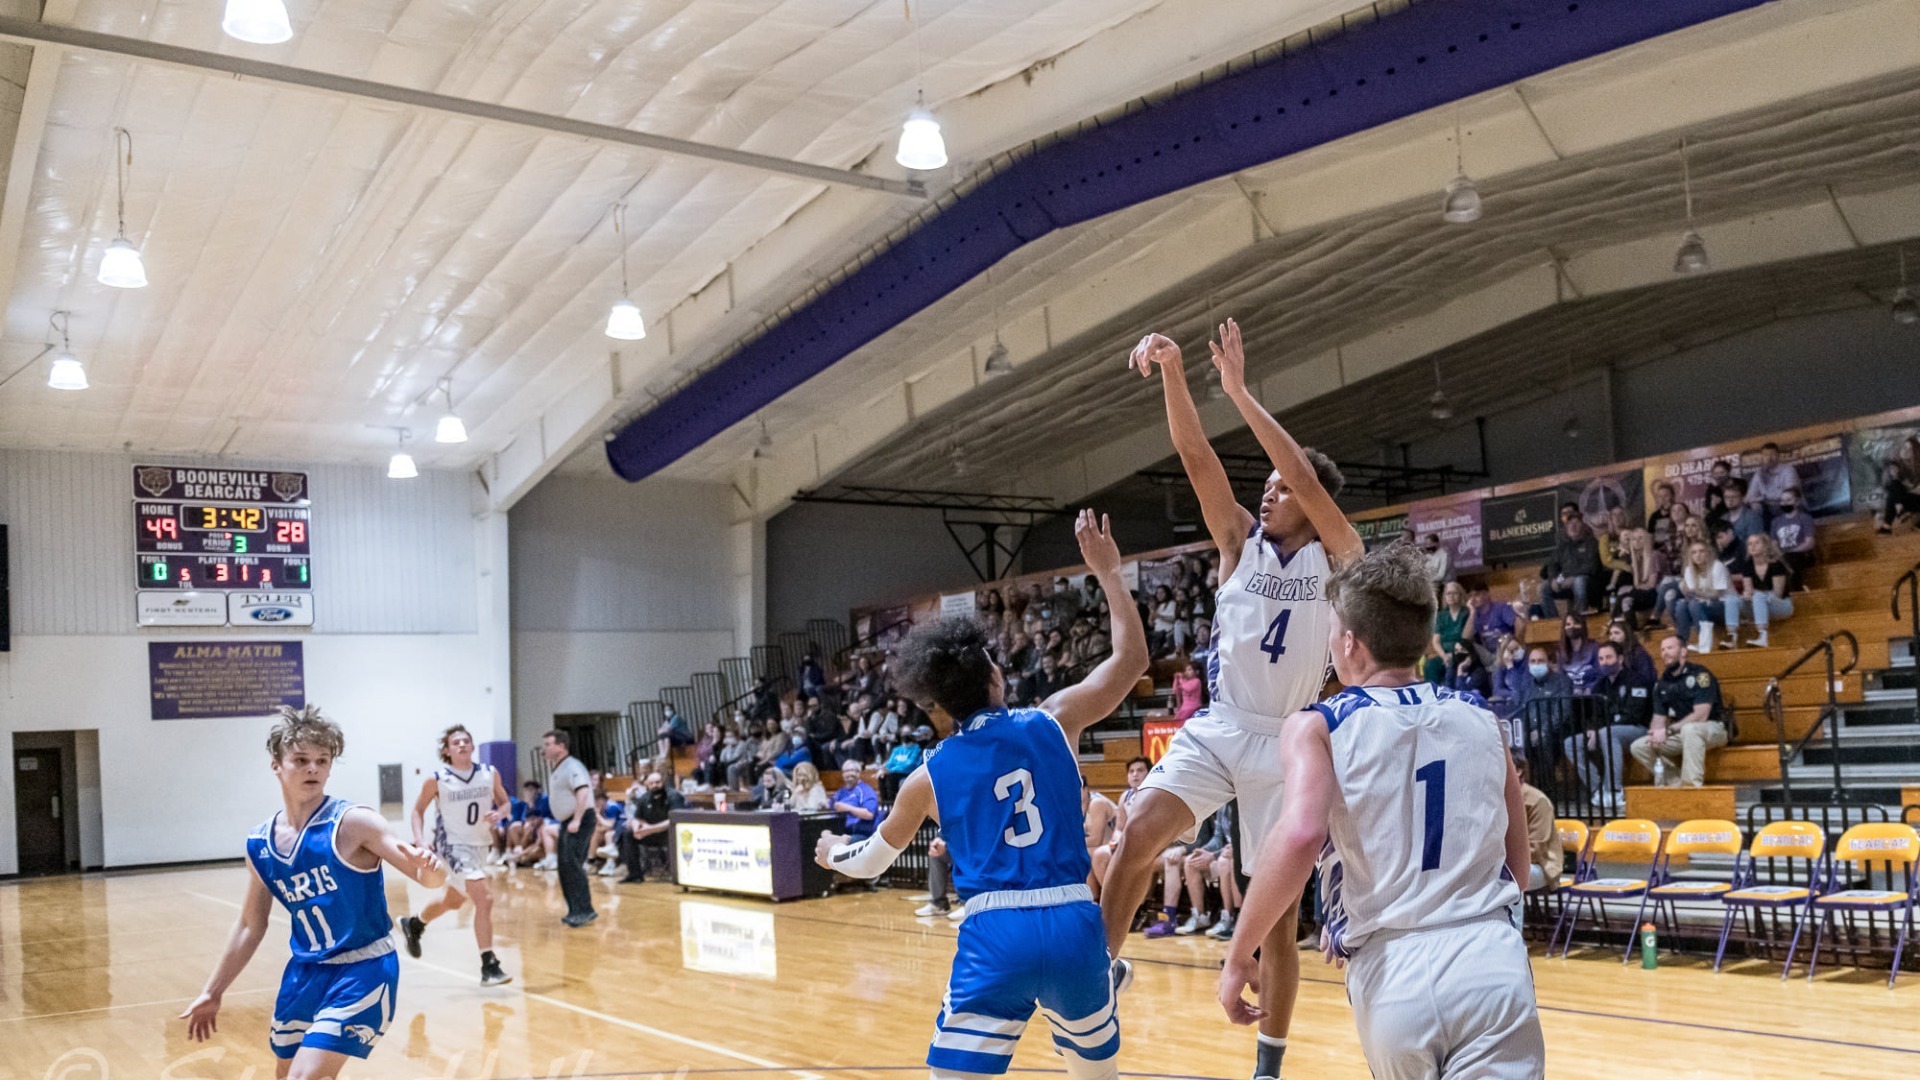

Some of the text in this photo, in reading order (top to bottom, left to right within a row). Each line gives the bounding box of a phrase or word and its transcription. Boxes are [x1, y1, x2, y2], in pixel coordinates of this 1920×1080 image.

[1681, 454, 1739, 475] BEARTS
[176, 470, 268, 487] BOONEVILLE
[184, 484, 262, 500] BEARCATS
[141, 505, 174, 515] HOME
[202, 507, 260, 530] 3:42
[268, 508, 308, 519] VISITOR
[146, 518, 177, 540] 49
[276, 521, 305, 543] 28
[1490, 520, 1554, 541] BLANKENSHIP
[157, 542, 183, 550] BONUS
[202, 538, 231, 547] PERIOD
[234, 535, 248, 553] 3
[266, 544, 291, 552] BONUS
[141, 556, 167, 564] FOULS
[198, 556, 259, 565] PLAYER FOULS
[283, 558, 307, 566] FOULS
[153, 563, 168, 581] 0
[240, 594, 302, 604] TYLER
[257, 609, 285, 622] Ford
[1260, 608, 1292, 664] 4
[174, 644, 283, 659] ALMA MATER
[467, 801, 479, 826] 0
[993, 768, 1044, 848] 3
[1415, 759, 1446, 872] 1
[274, 864, 338, 903] ARIS
[297, 905, 336, 952] 11
